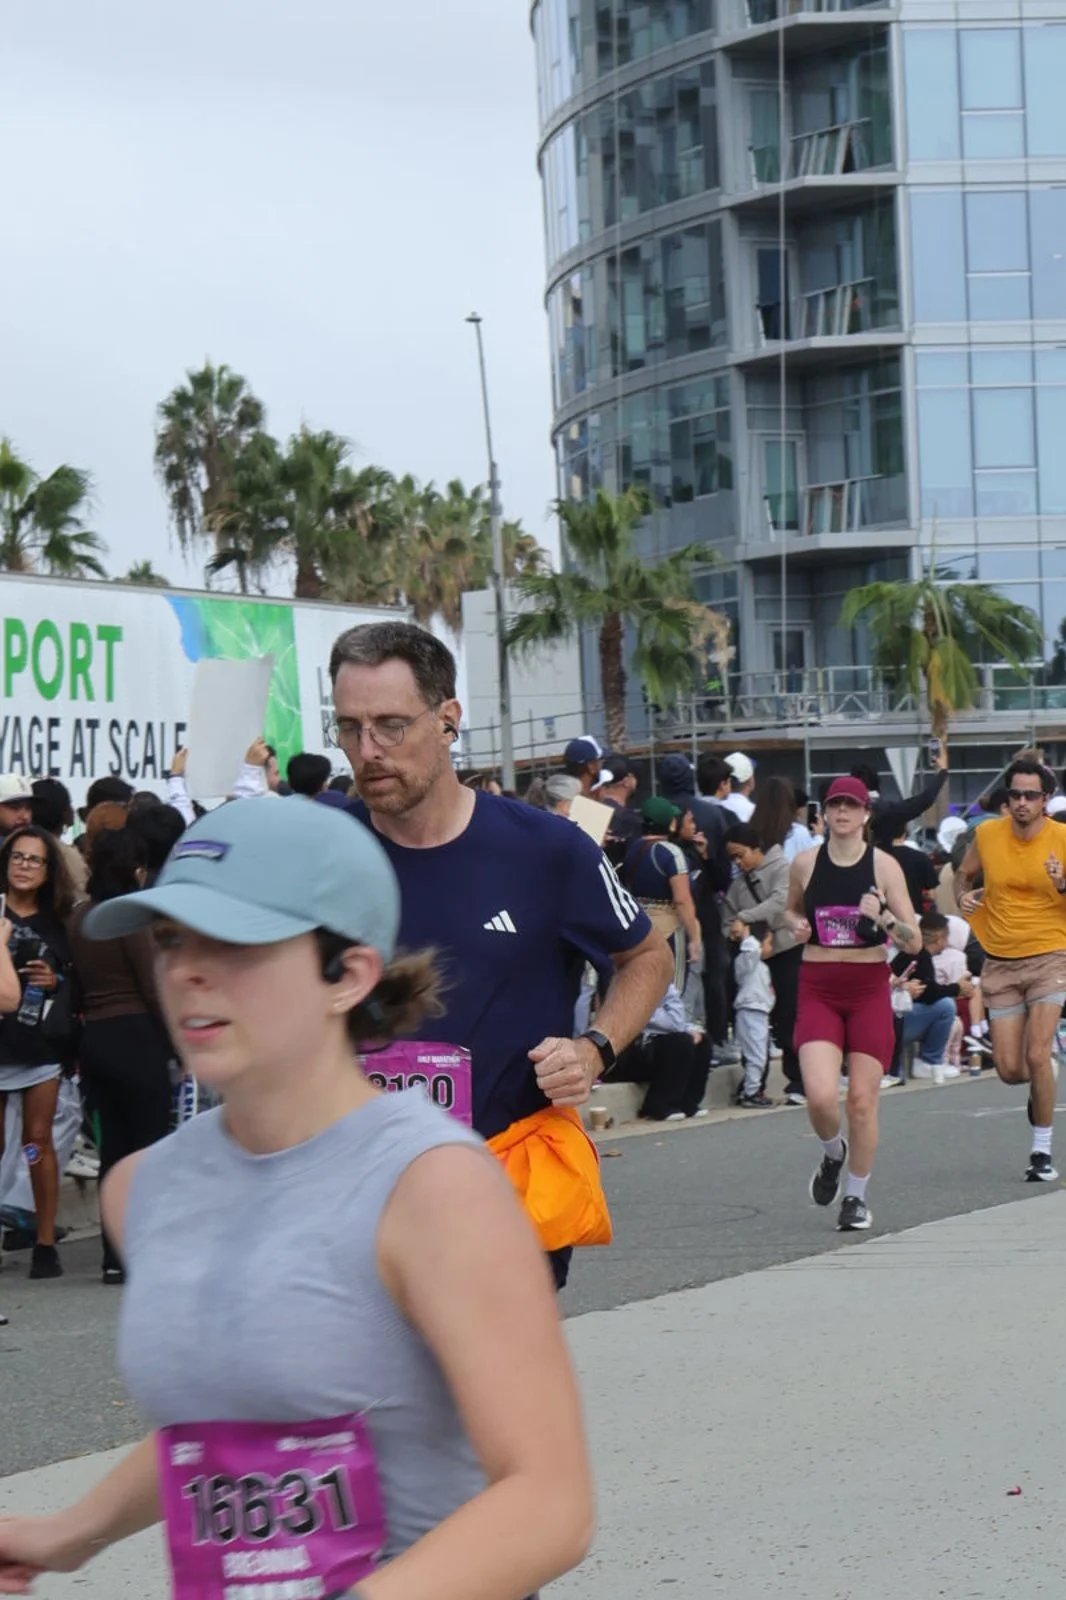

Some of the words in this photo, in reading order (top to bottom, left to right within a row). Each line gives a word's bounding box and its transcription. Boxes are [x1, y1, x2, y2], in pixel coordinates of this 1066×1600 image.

[4, 617, 123, 703] PORT
[69, 718, 100, 778] AT
[182, 1464, 358, 1546] 16631
